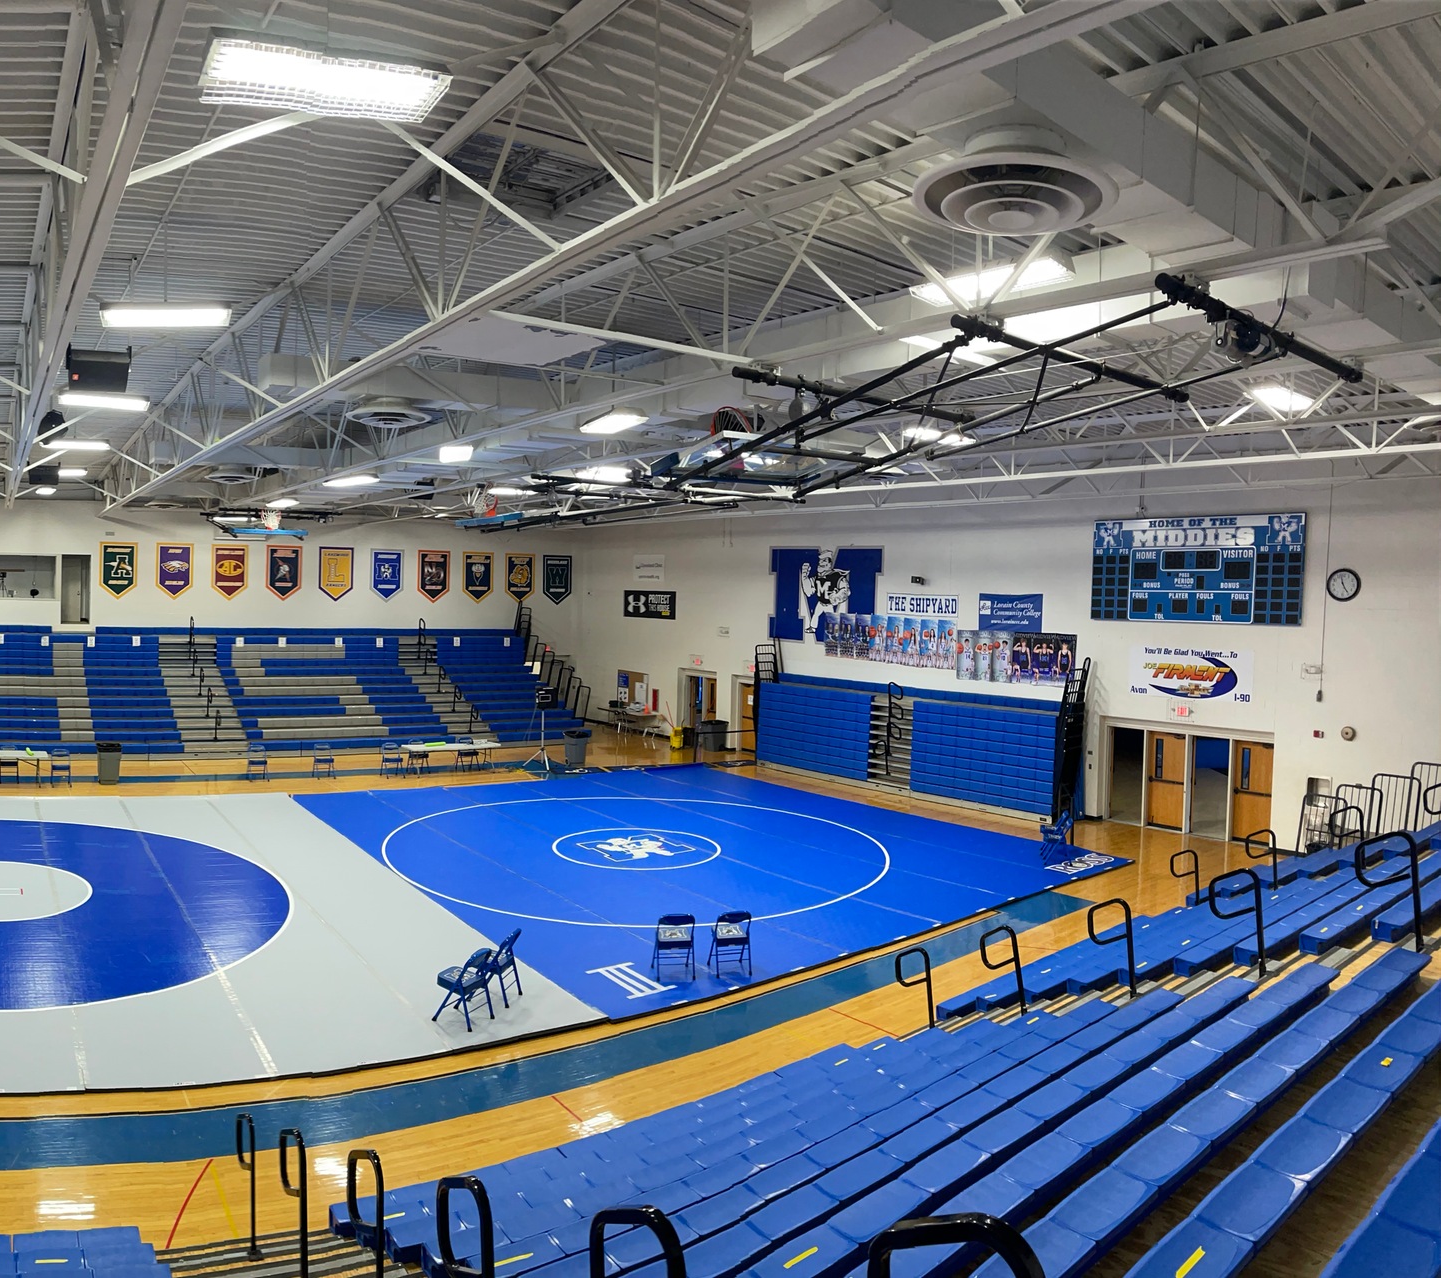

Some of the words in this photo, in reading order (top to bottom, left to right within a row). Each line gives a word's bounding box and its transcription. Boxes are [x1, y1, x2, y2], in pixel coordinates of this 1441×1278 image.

[1149, 519, 1184, 528] HOME
[1188, 518, 1204, 527] OF
[1210, 517, 1237, 526] THE
[1132, 527, 1255, 546] MIDDIES
[1136, 551, 1157, 560] HOME
[1223, 550, 1254, 558] VISITOR
[111, 555, 133, 578] A
[327, 558, 345, 582] L
[816, 581, 831, 600] M
[648, 594, 671, 604] PROTECT
[888, 596, 906, 612] THE
[909, 597, 957, 614] SHIPYARD
[1013, 601, 1033, 610] County
[993, 610, 1023, 618] Community
[1024, 610, 1042, 618] College
[1152, 663, 1231, 682] FIRMENT
[1130, 686, 1148, 694] Avon
[1234, 694, 1250, 702] I-90
[1044, 852, 1115, 875] ROSS
